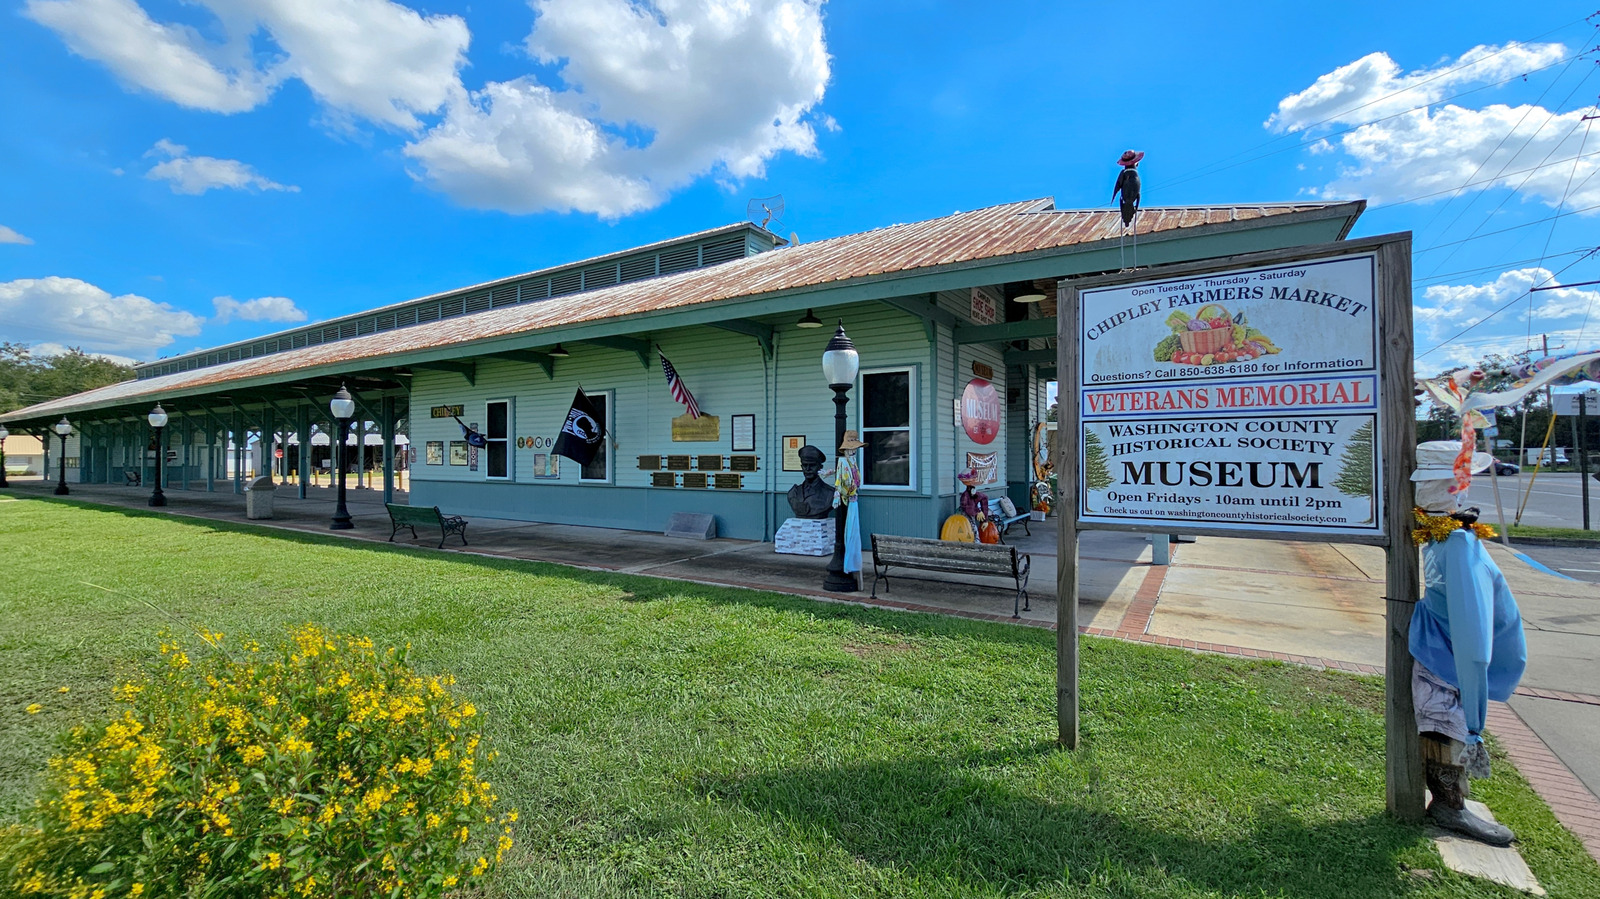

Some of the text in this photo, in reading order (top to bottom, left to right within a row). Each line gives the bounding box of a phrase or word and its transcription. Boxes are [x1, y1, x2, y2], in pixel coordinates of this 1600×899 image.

[1131, 287, 1155, 297] Open
[1158, 281, 1195, 294] Tuesday
[1203, 276, 1250, 287] Thursday
[1260, 269, 1306, 281] Saturday
[973, 296, 984, 313] SHOE
[984, 304, 994, 318] SHOP
[1086, 286, 1368, 342] CHIPLEY FARMERS MARKET
[1091, 358, 1364, 382] Questions? Call 850-638-6180 for Information
[1087, 382, 1370, 413] VETERANS MEMORIAL
[966, 398, 998, 422] MUSEUM
[1108, 420, 1339, 437] WASHINGTON COUNTY
[1112, 437, 1335, 456] HISTORICAL SOCIETY
[1121, 461, 1323, 489] MUSEUM
[1107, 491, 1142, 503] Open
[1147, 492, 1201, 506] Fridays
[1215, 494, 1256, 506] 10am
[1260, 495, 1299, 507] until
[1305, 496, 1342, 510] 2pm
[1103, 506, 1127, 514] Check
[1167, 509, 1347, 524] washingtoncountyhistoricalsociety.com
